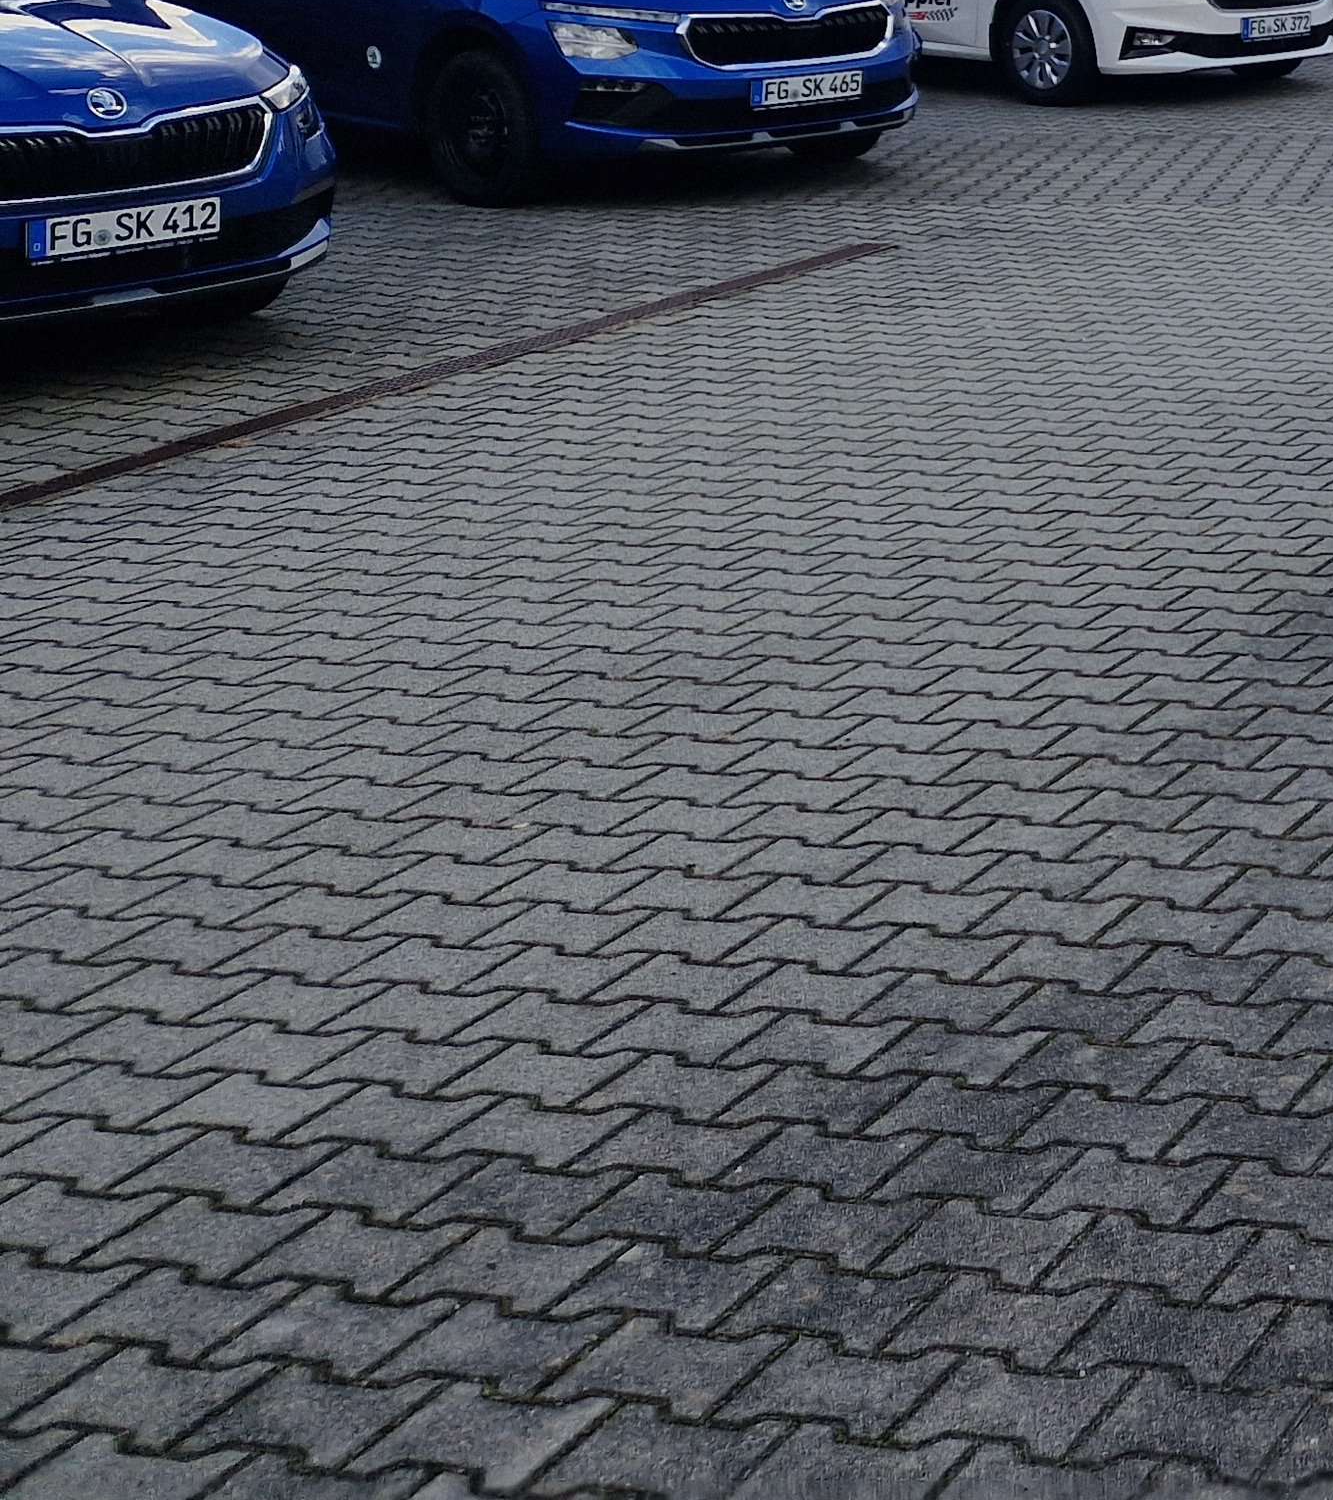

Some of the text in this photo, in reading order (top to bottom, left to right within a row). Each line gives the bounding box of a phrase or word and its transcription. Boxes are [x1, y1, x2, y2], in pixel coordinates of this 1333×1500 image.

[1250, 15, 1310, 35] FG SK 372
[765, 80, 789, 102] FG
[801, 76, 825, 98] SK
[830, 73, 860, 94] 465
[50, 218, 92, 251] FG
[115, 209, 155, 242] SK
[162, 201, 217, 235] 412
